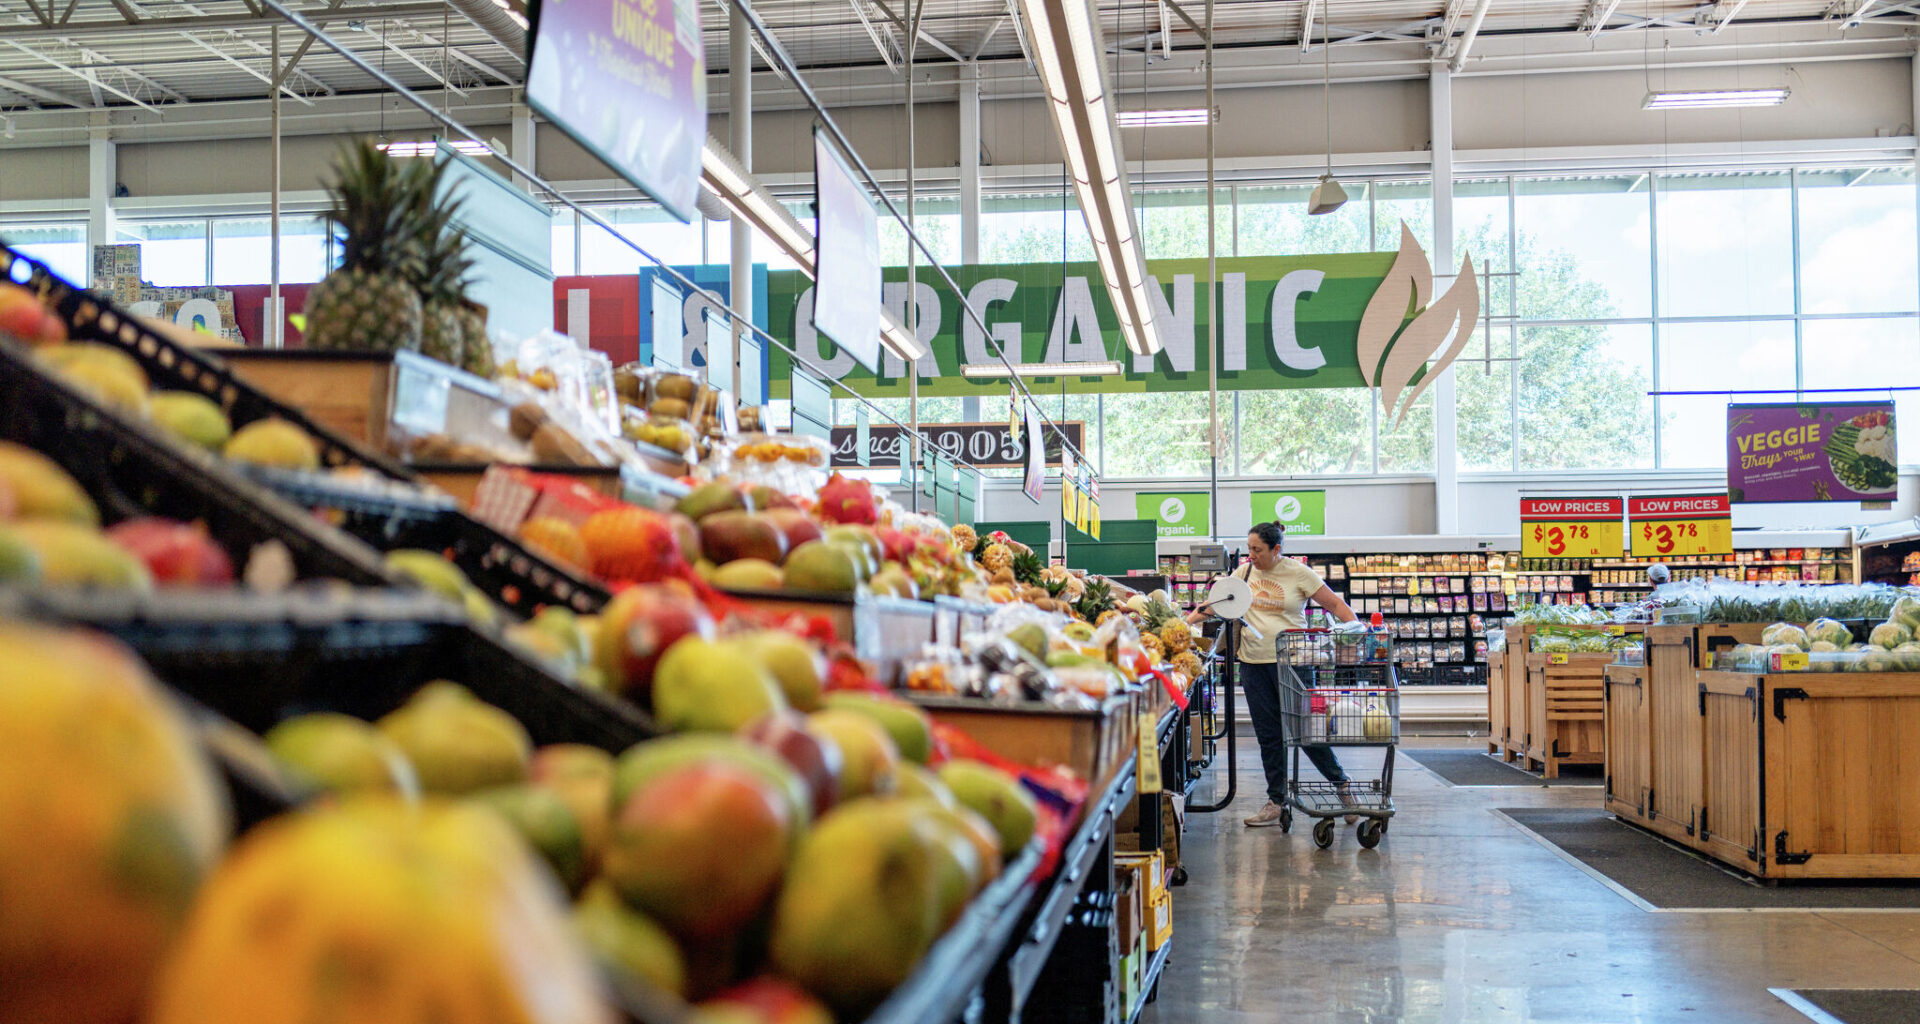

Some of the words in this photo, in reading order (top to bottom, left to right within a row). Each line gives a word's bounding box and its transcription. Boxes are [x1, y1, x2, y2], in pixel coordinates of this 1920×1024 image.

[613, 0, 674, 69] UNIQUE
[796, 268, 1327, 380] ORGANIC
[1736, 423, 1821, 454] VEGGIE
[1741, 451, 1783, 470] Trays
[1783, 447, 1804, 458] YOUR
[1799, 452, 1816, 461] WAY
[1532, 502, 1562, 513] LOW
[1565, 502, 1610, 512] PRICES
[1640, 500, 1670, 512] LOW
[1673, 499, 1719, 511] PRICES
[1157, 523, 1195, 536] rganic
